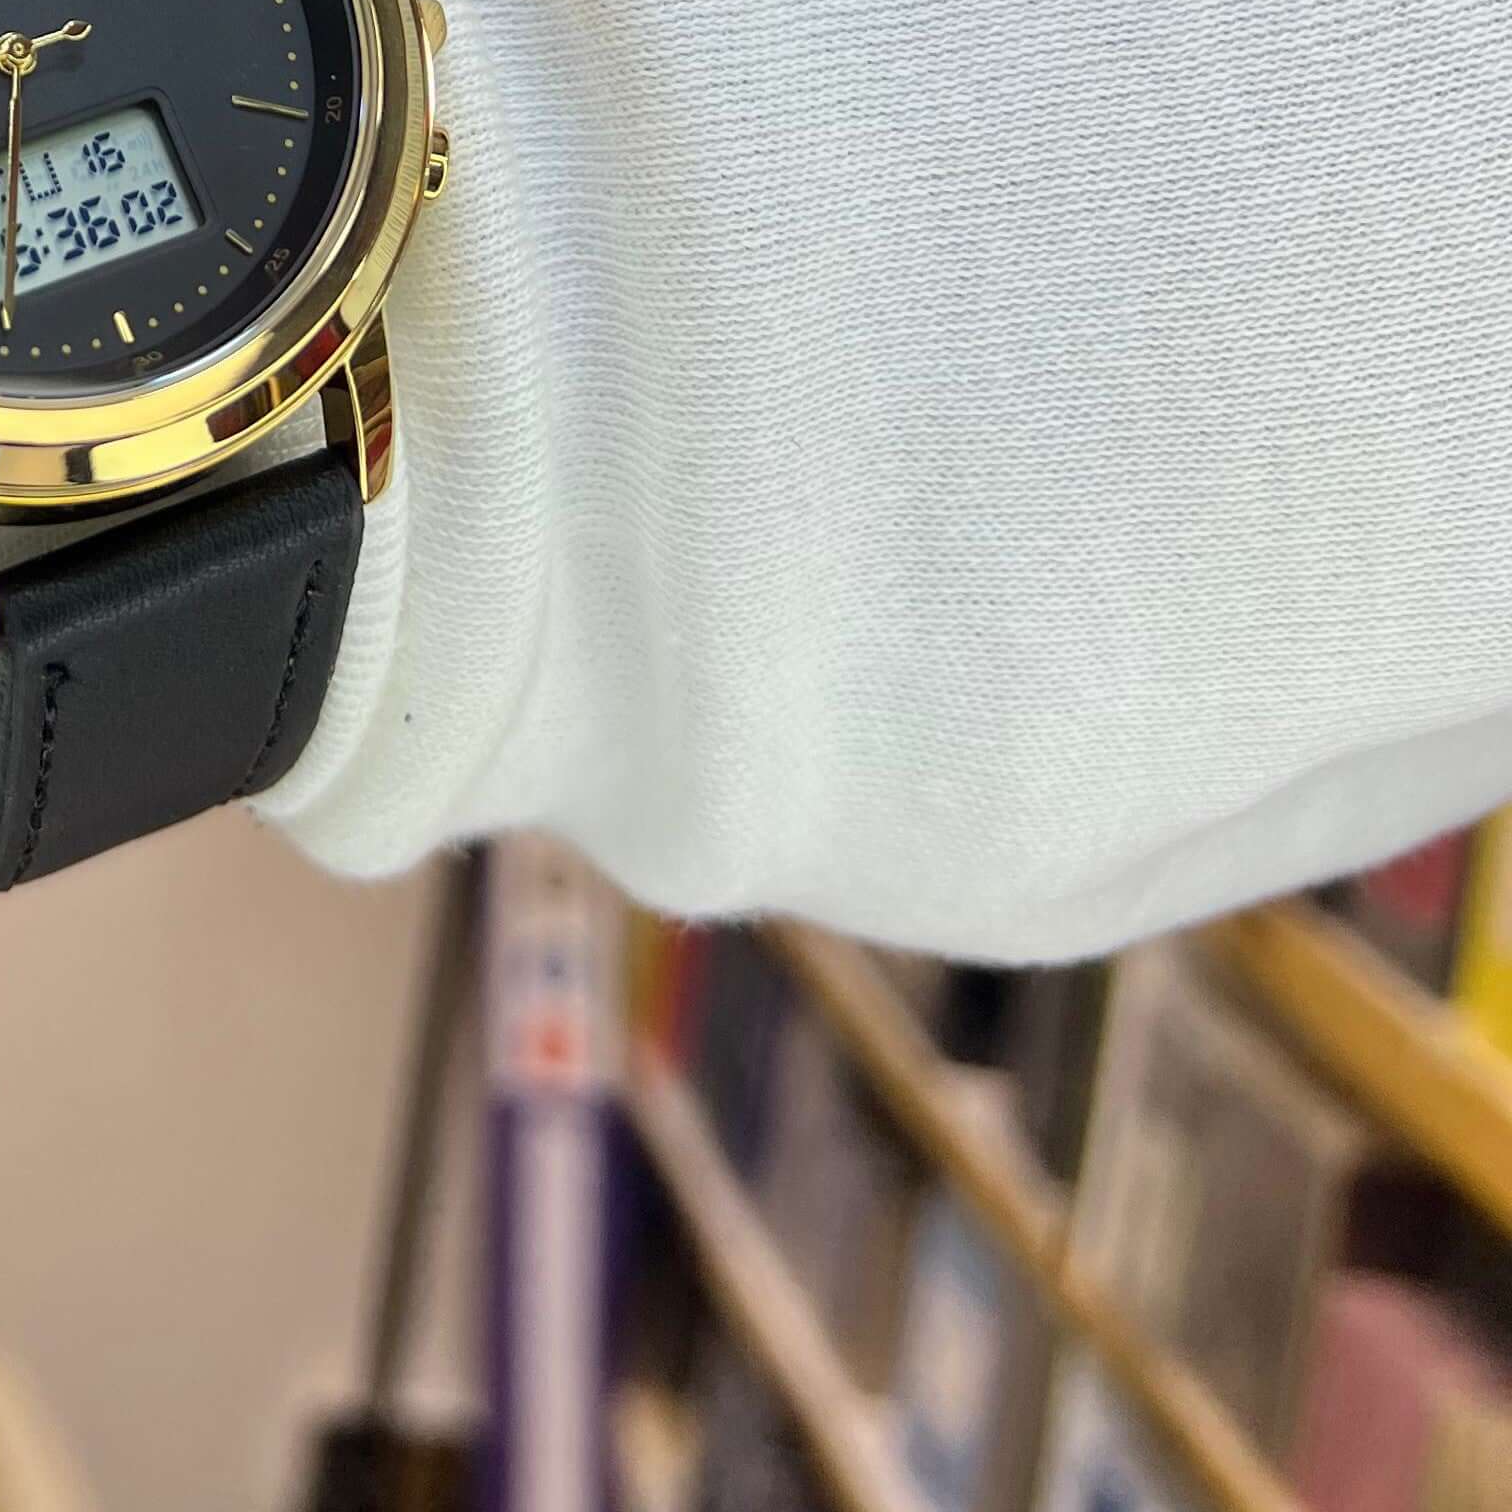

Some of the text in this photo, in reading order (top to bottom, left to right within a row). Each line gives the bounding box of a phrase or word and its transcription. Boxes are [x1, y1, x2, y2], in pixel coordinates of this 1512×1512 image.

[325, 95, 343, 124] 20
[82, 130, 126, 174] 16
[263, 247, 291, 273] 25
